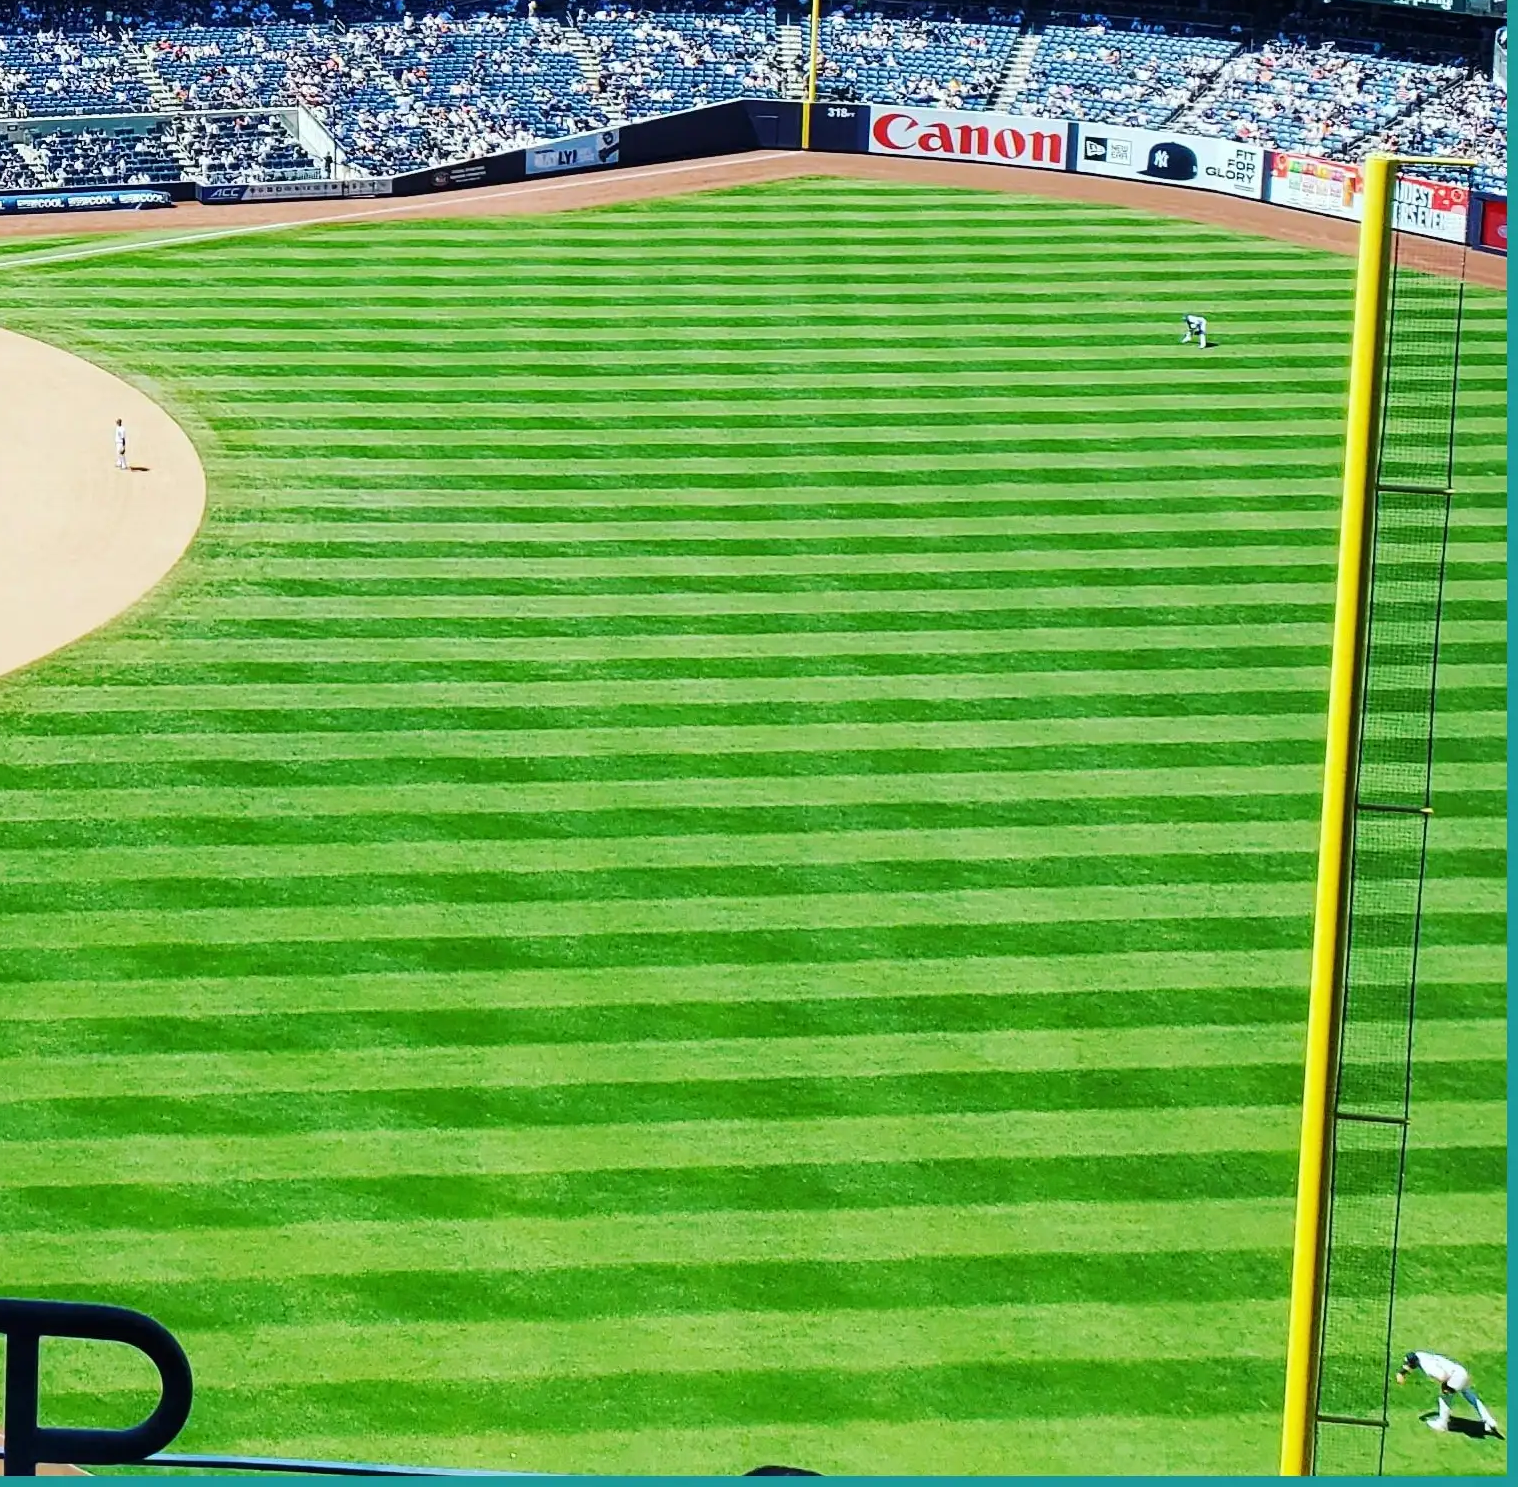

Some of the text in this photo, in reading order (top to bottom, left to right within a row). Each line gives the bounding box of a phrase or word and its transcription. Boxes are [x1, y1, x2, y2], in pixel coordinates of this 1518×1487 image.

[872, 113, 1062, 164] Canon
[1111, 144, 1129, 153] NEW
[1110, 151, 1128, 160] ERA
[1236, 149, 1257, 161] FIT
[1228, 159, 1256, 172] FOR
[1205, 166, 1255, 184] GLORY
[210, 187, 240, 198] ACC
